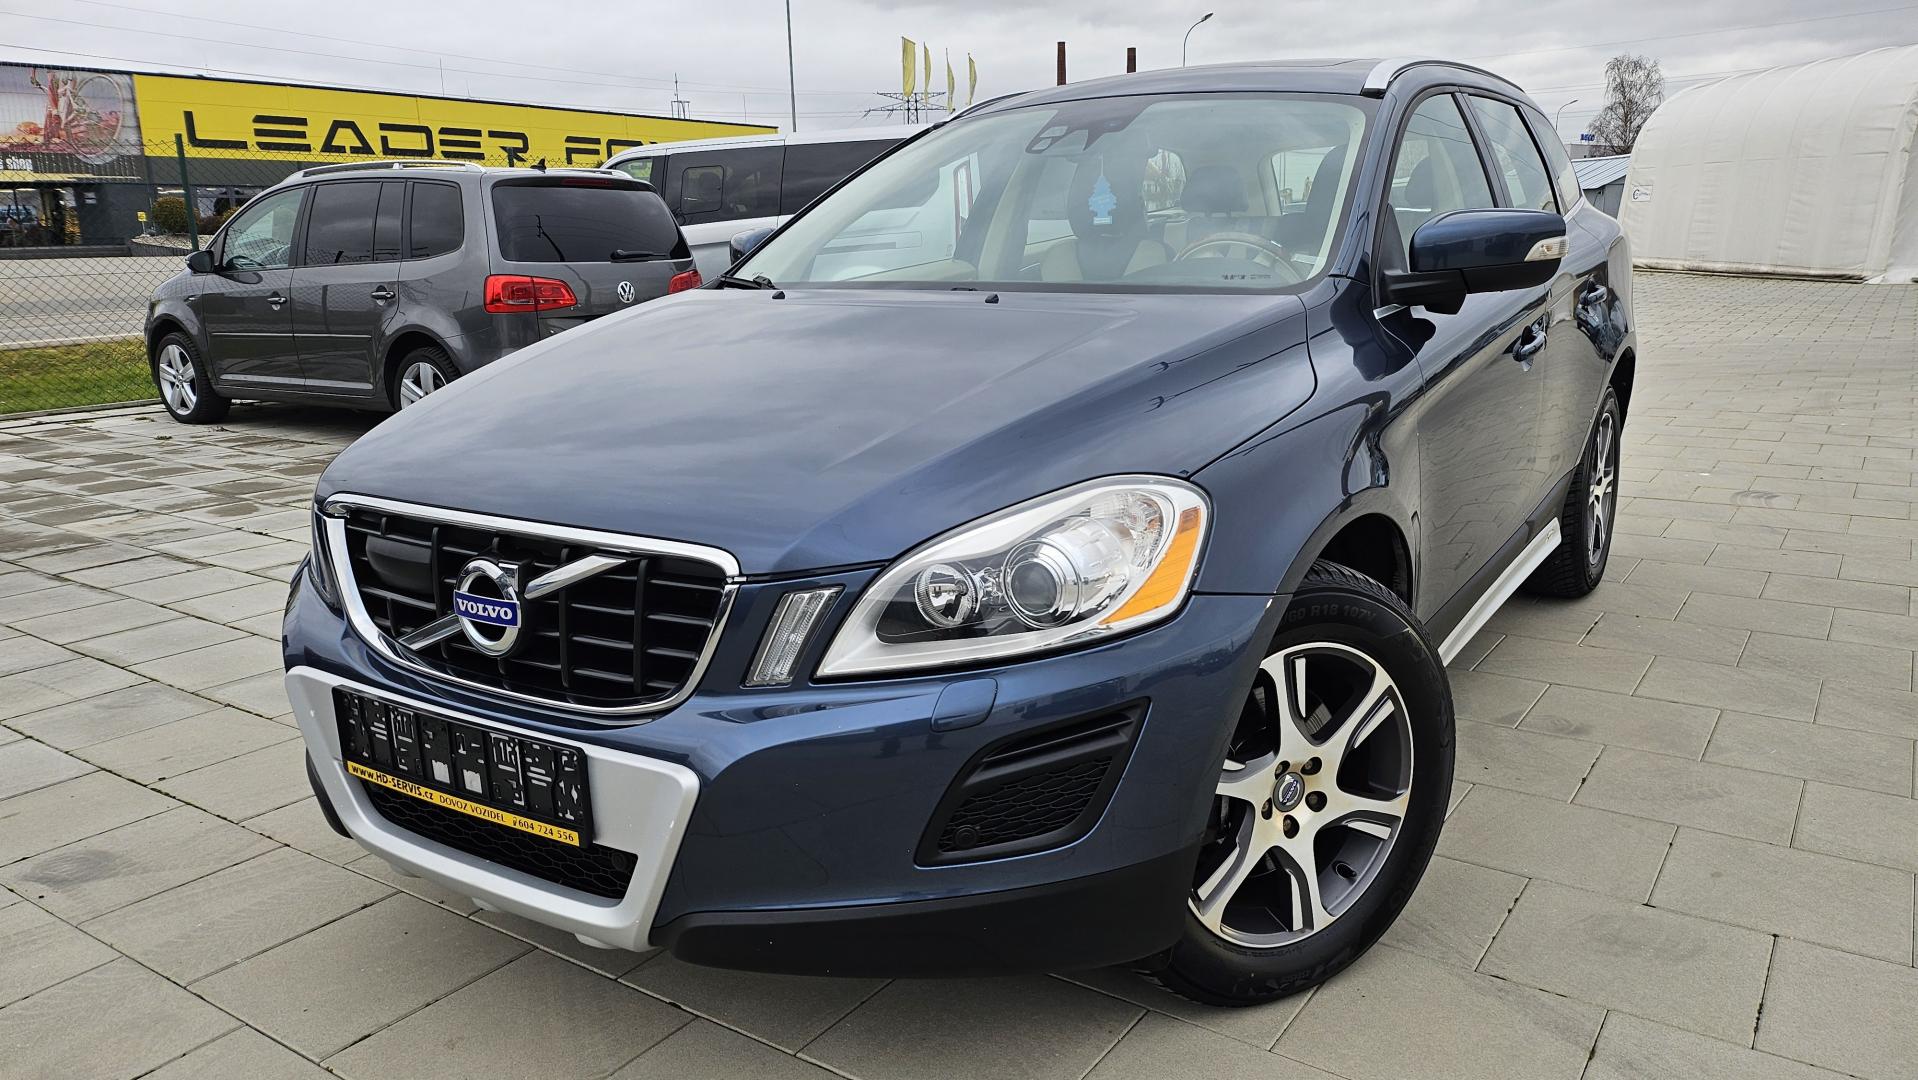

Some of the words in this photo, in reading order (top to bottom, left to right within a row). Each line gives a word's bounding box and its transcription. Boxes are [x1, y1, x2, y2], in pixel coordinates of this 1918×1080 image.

[183, 110, 530, 163] LEADER
[456, 597, 513, 620] VOLVO
[351, 765, 434, 801] www.HD-SERVIS.cz
[439, 794, 468, 812] DOVOZ
[470, 804, 506, 823] VOZIDEL
[518, 820, 535, 831] 604
[538, 824, 554, 837] 724
[557, 829, 574, 842] 556
